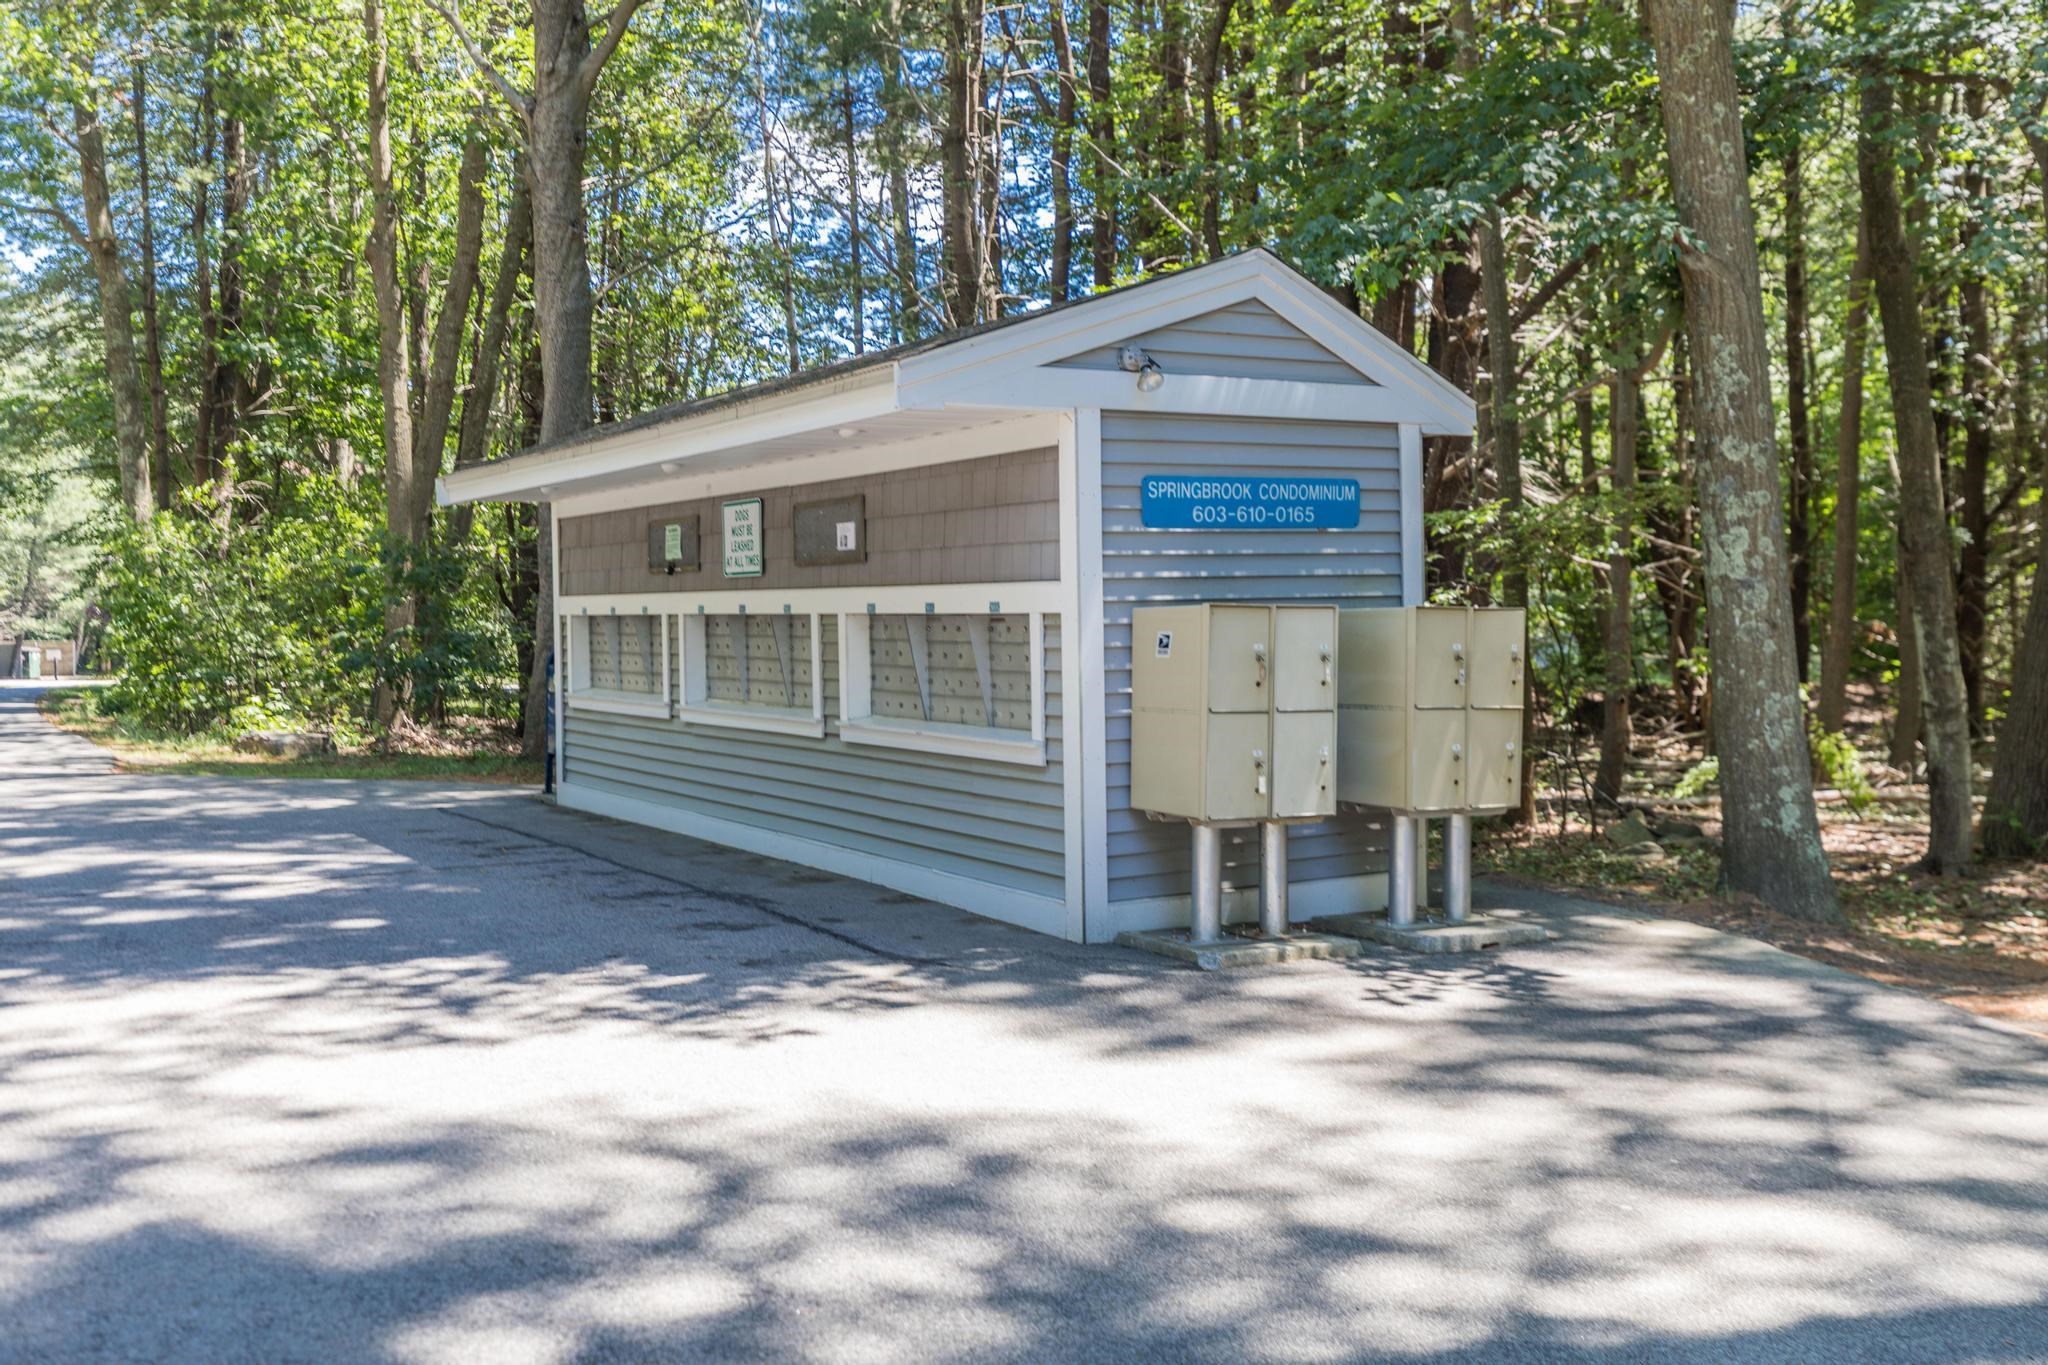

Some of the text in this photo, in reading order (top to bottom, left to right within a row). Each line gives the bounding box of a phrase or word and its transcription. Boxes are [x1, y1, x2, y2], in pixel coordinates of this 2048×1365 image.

[1147, 481, 1356, 501] SPRINGBROOK CONDOMINIUM
[735, 509, 749, 521] DOGS
[1192, 506, 1315, 523] 603-610-0165
[731, 524, 753, 537] MUST BE
[731, 540, 754, 552] LEASHED
[727, 554, 760, 568] AT ALL TIMES
